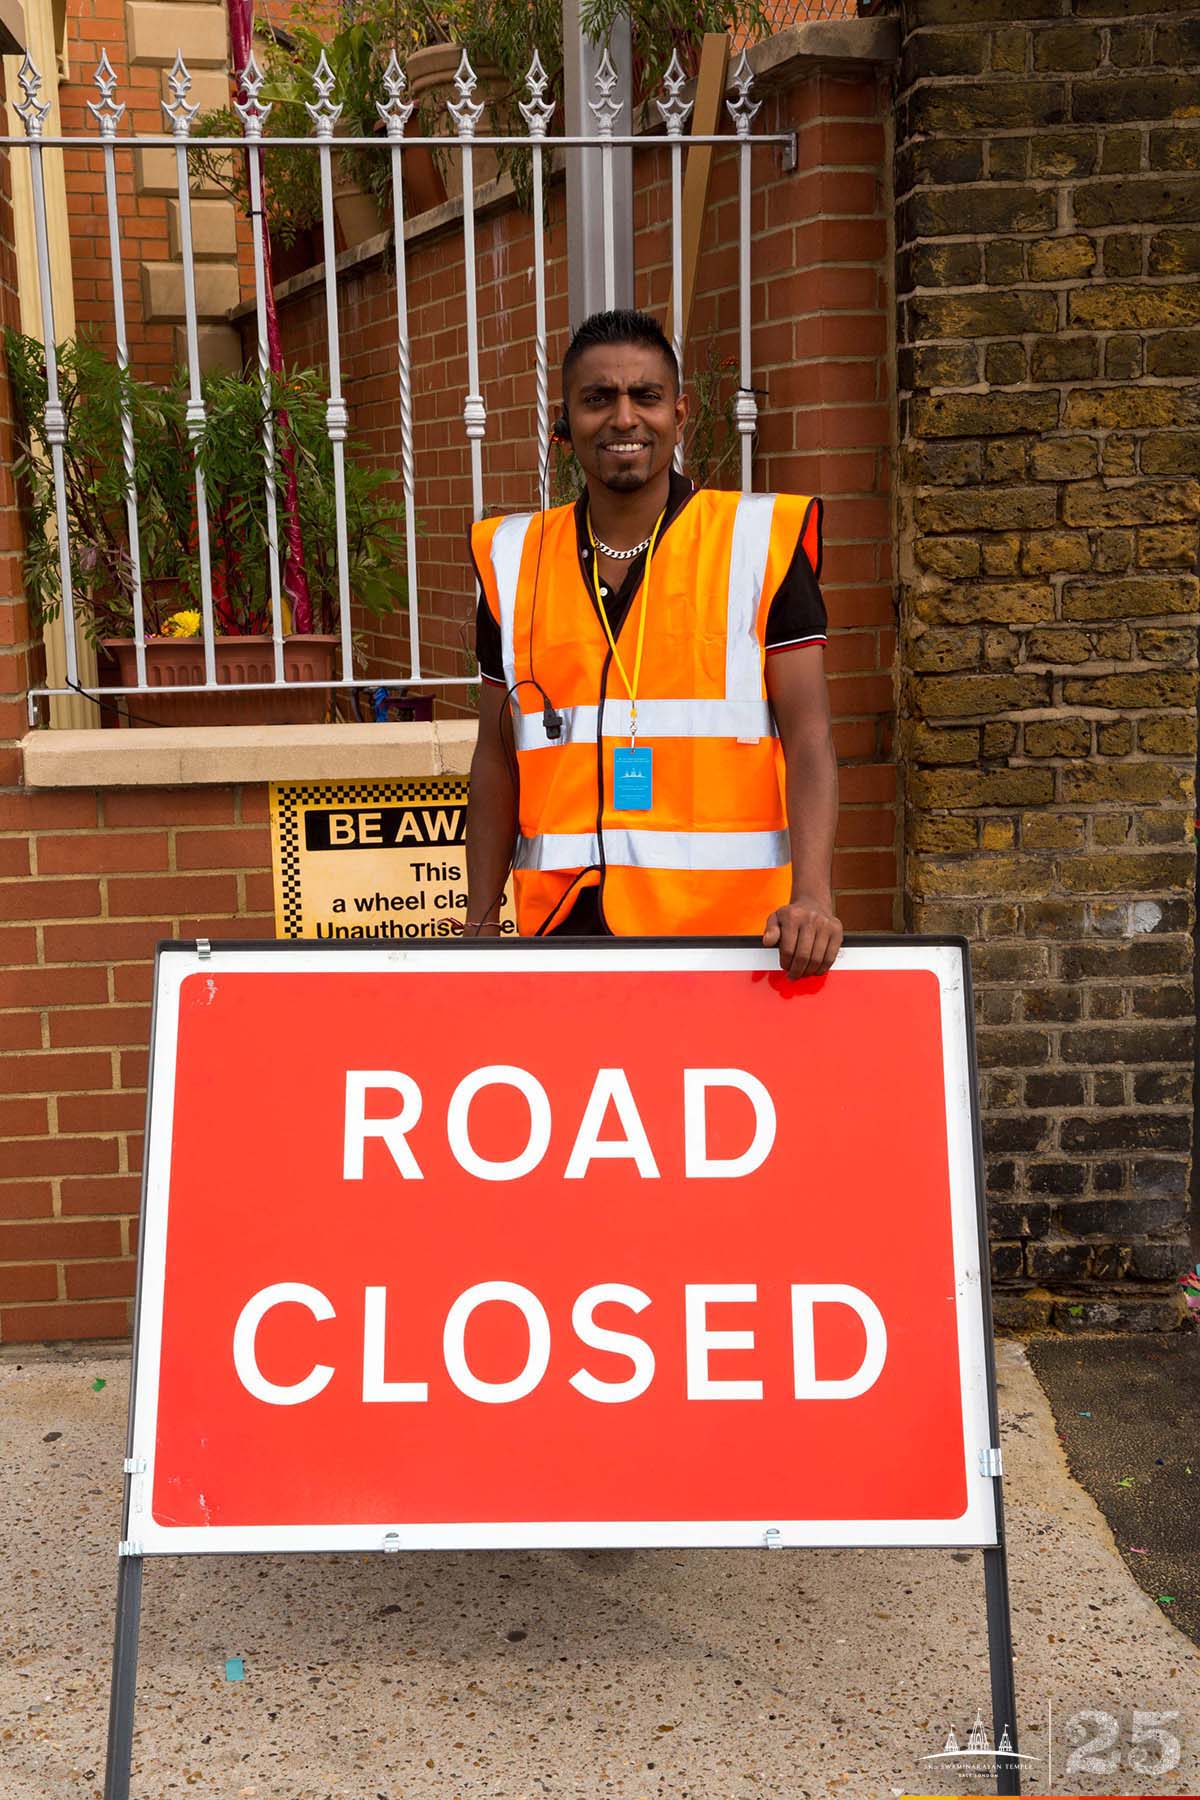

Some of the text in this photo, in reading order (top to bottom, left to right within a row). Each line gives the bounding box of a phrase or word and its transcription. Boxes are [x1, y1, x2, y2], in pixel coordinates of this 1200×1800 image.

[329, 812, 382, 845] BE
[410, 863, 461, 882] This
[332, 898, 346, 912] a
[354, 890, 425, 911] wheel
[316, 919, 464, 939] Unauthorise
[344, 1065, 776, 1181] ROAD
[233, 1281, 887, 1405] CLOSED
